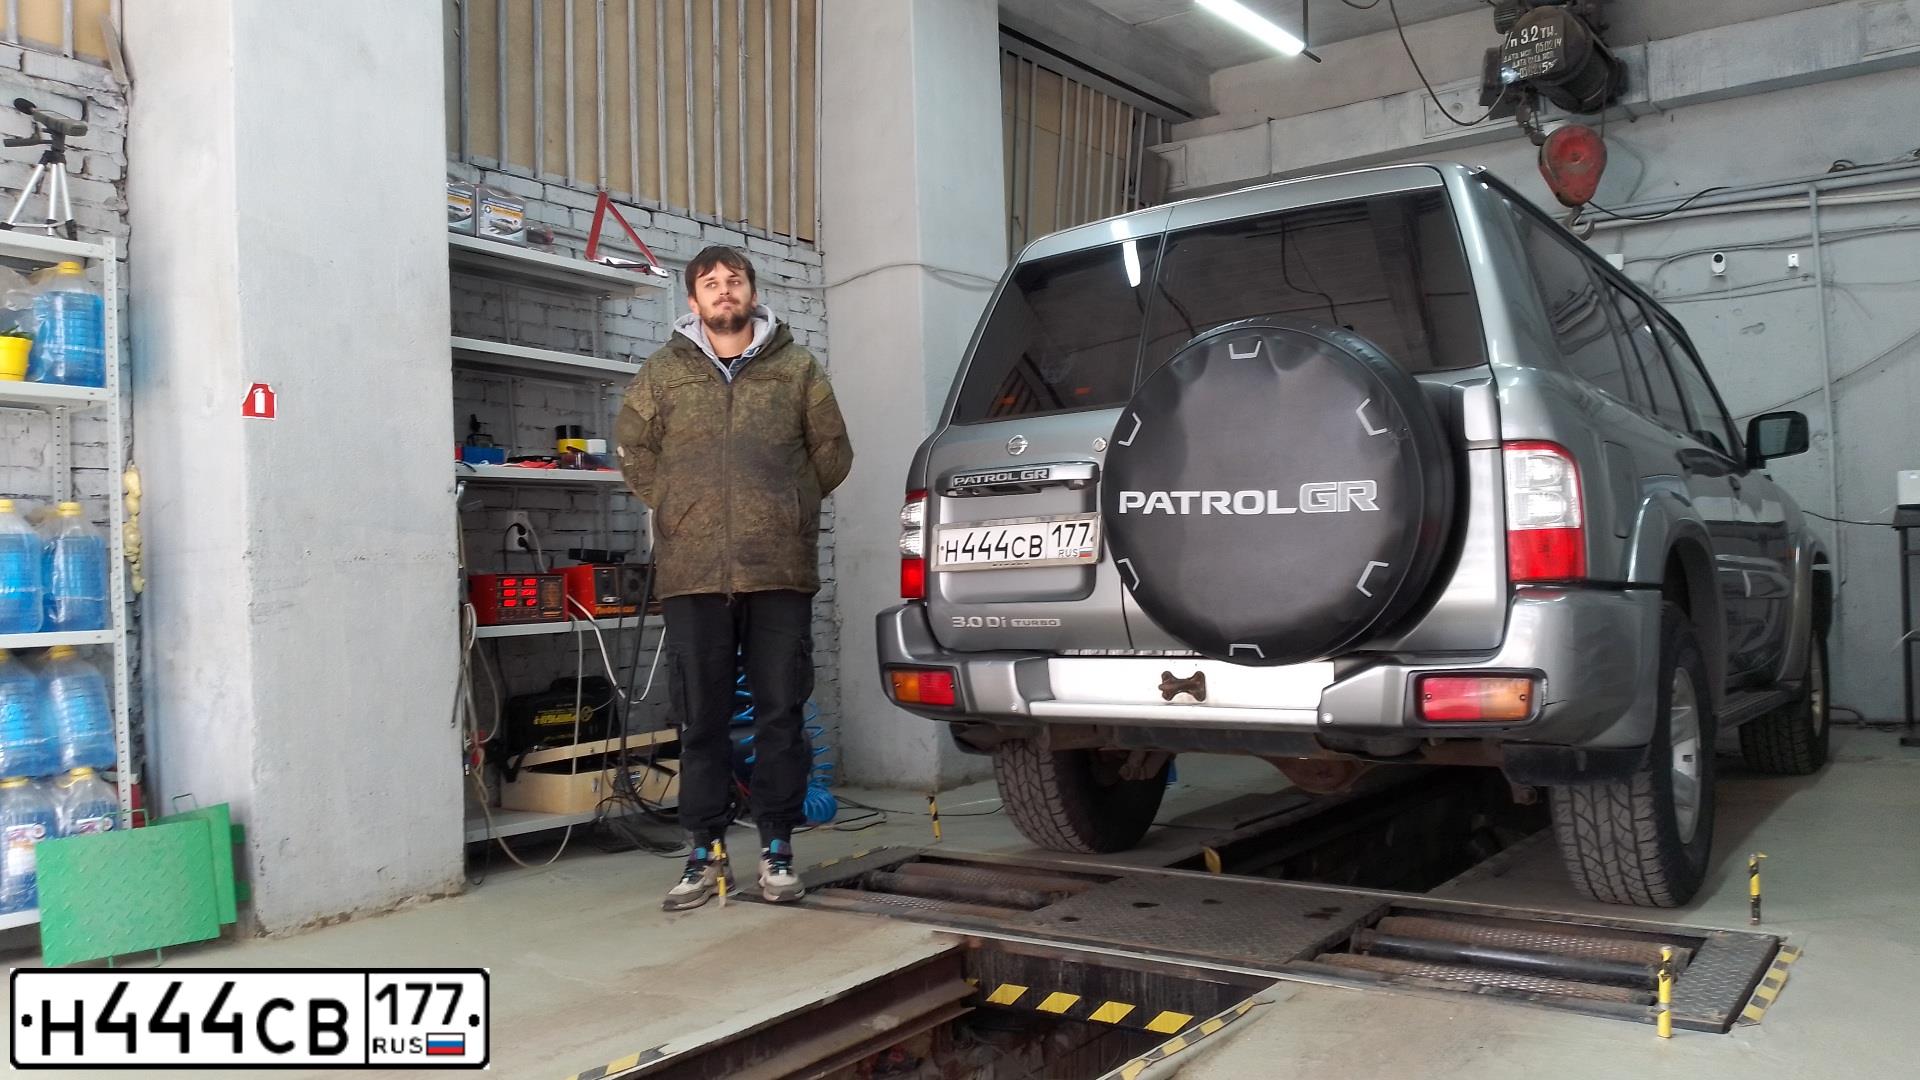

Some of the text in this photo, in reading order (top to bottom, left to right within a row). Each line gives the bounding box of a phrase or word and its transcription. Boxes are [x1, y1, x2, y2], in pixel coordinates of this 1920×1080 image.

[954, 469, 1048, 486] PATROL GR
[1118, 480, 1380, 515] PATROL GR
[1052, 523, 1090, 547] 177
[1058, 548, 1080, 557] RUS
[951, 616, 983, 628] 3.0
[1012, 618, 1059, 627] TURBO
